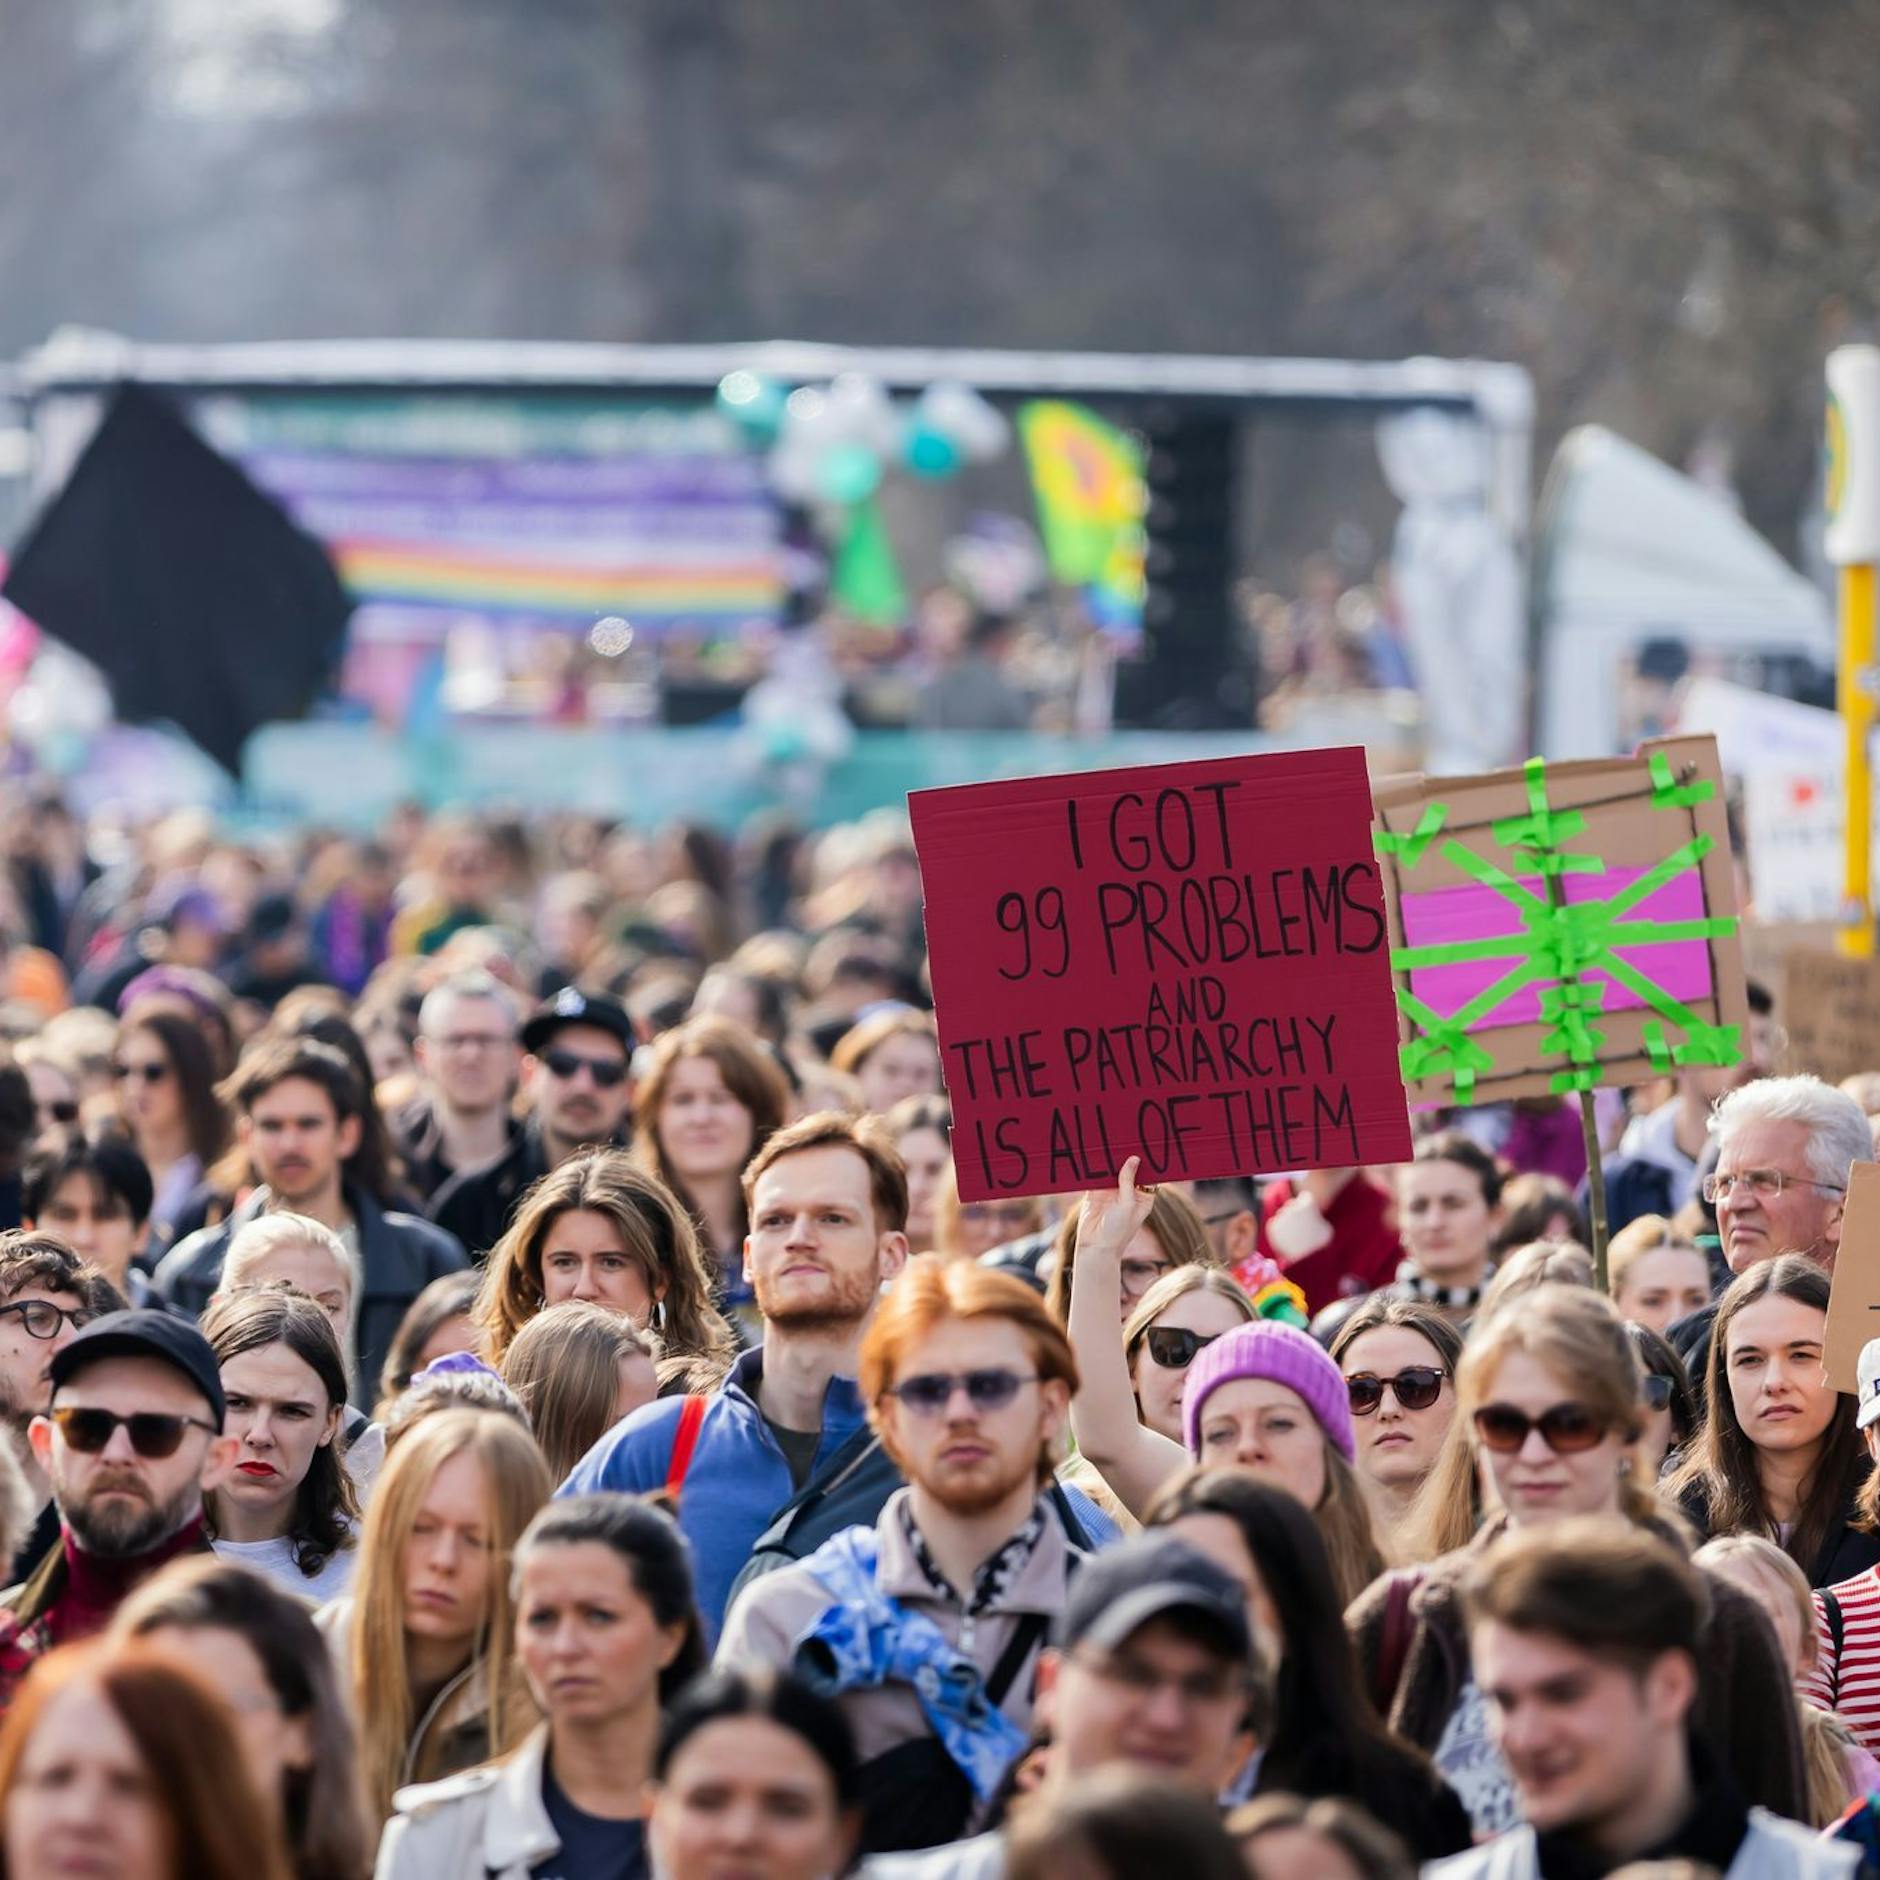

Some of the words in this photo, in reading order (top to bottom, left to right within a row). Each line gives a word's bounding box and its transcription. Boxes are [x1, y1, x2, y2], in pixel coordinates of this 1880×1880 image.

[1068, 800, 1084, 869] I
[1109, 782, 1242, 872] GOT
[996, 886, 1071, 980] 99
[1098, 862, 1385, 975] PROBLEMS
[1147, 976, 1227, 1026] AND
[950, 1030, 1052, 1100] THE
[1063, 1014, 1336, 1092] PATRIARCHY
[976, 1117, 1029, 1190] IS
[1049, 1105, 1118, 1184] ALL
[1137, 1095, 1200, 1174] OF
[1208, 1083, 1361, 1170] THEM
